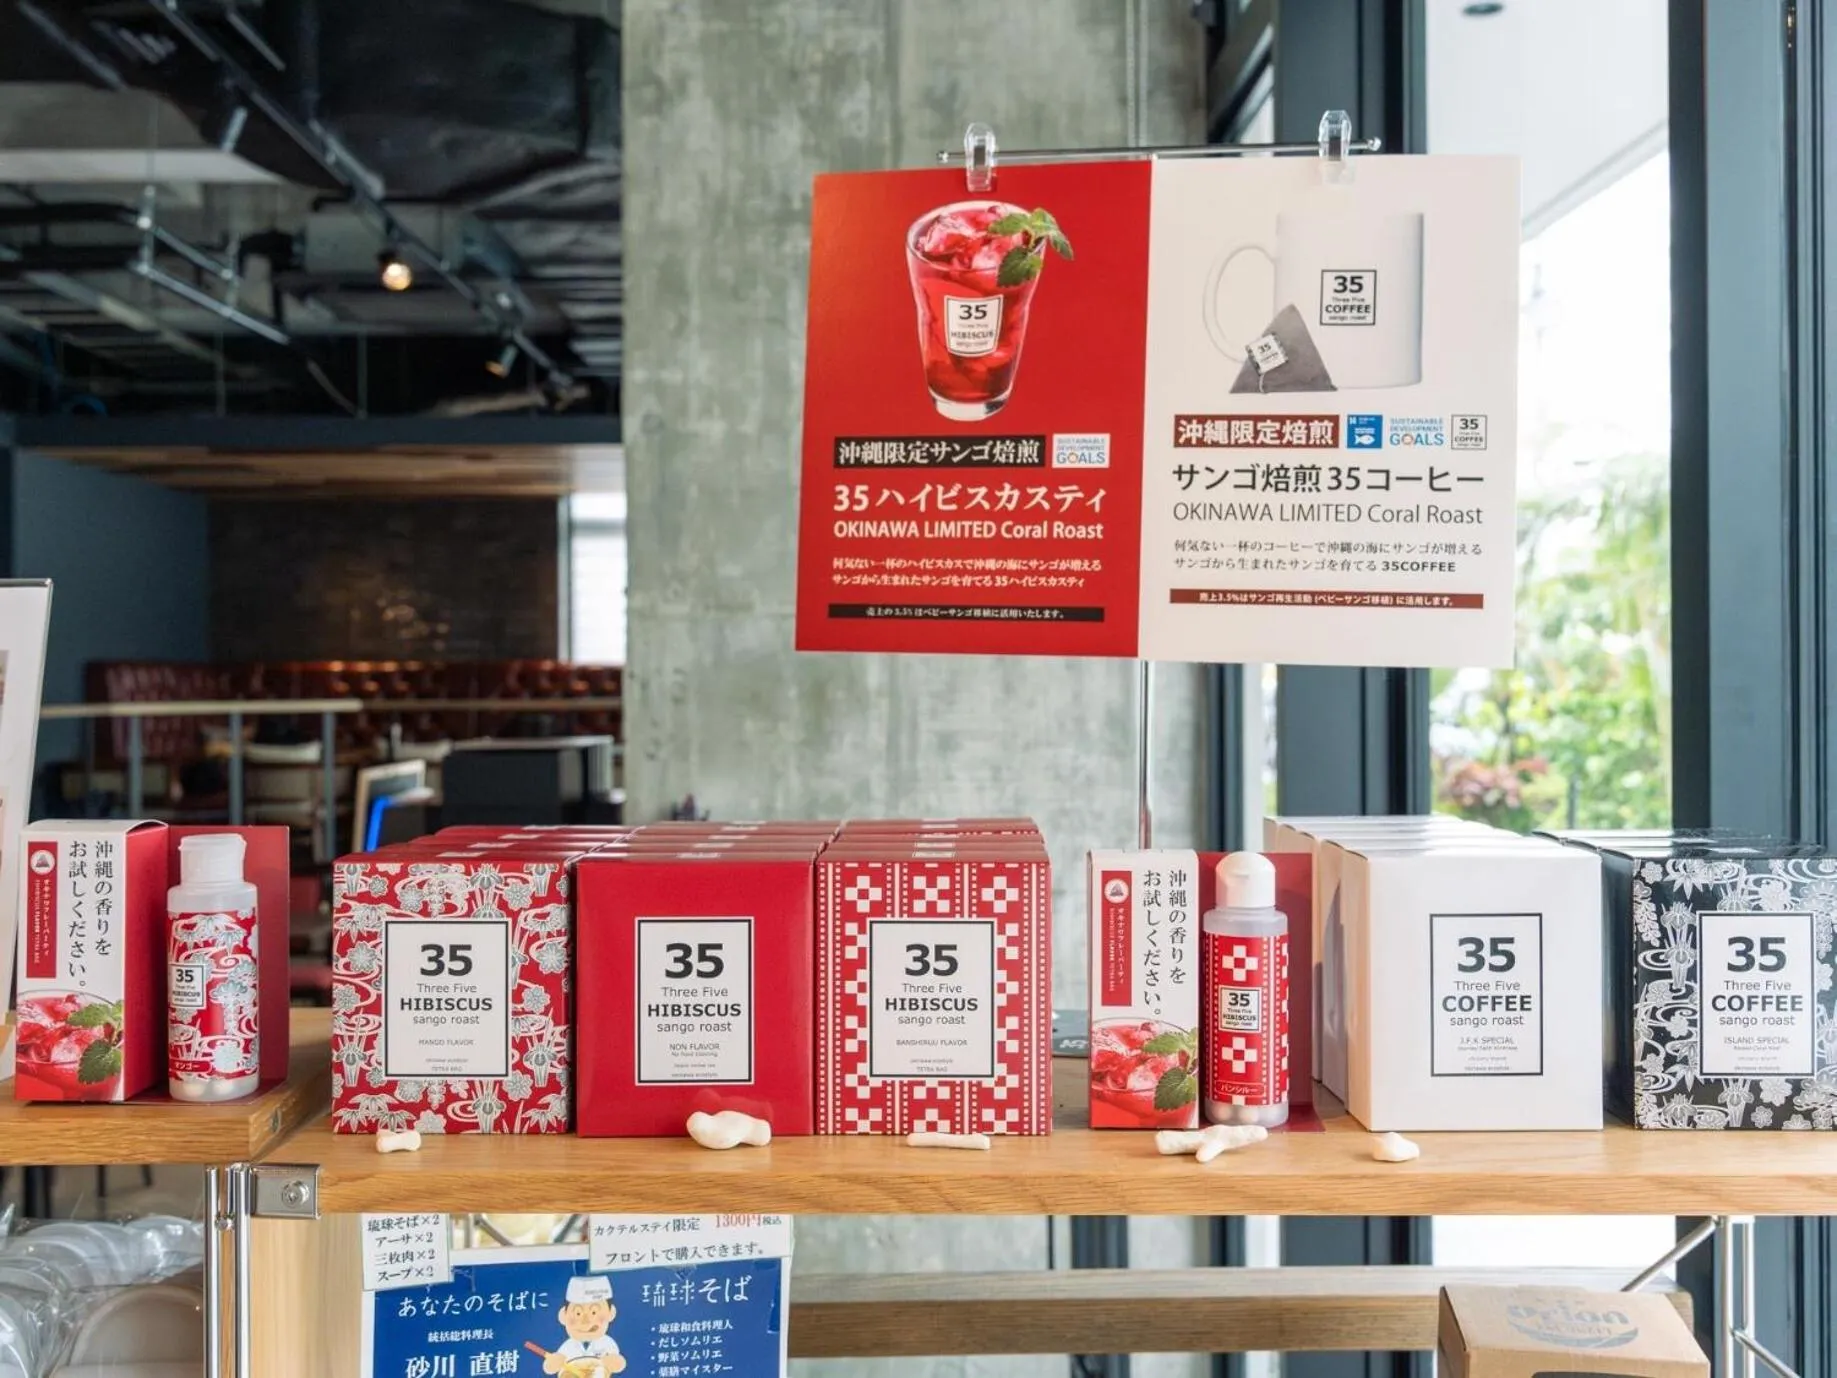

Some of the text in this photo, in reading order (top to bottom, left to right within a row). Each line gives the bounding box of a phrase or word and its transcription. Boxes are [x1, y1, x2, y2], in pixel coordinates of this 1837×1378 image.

[1333, 275, 1364, 294] 35
[959, 304, 987, 320] 35
[1325, 304, 1371, 314] COFFEE
[1459, 418, 1479, 430] 35
[1177, 420, 1335, 446] 沖縄限定焙煎
[1389, 433, 1445, 446] GOALS
[838, 440, 1040, 464] 沖縄限定サンゴ焙煎
[1172, 463, 1485, 493] サンゴ焙煎35コーヒー
[1173, 502, 1483, 524] OKINAWA LIMITED Coral Roast
[833, 520, 1104, 540] OKINAWA LIMITED Coral Roast
[94, 840, 114, 957] 沖縄の香りを
[68, 841, 88, 988] お試しください。
[1168, 869, 1188, 985] 沖縄の香りを
[1143, 869, 1162, 1016] お試しください。
[420, 944, 473, 976] 35
[665, 943, 724, 979] 35
[905, 944, 958, 976] 35
[1457, 937, 1516, 973] 35
[1727, 936, 1787, 972] 35
[175, 968, 195, 983] 35
[417, 983, 477, 993] Three Five
[662, 987, 729, 997] Three Five
[902, 983, 962, 993] Three Five
[1454, 981, 1520, 991] Three Five
[1724, 980, 1792, 990] Three Five
[400, 998, 492, 1011] HIBISCUS
[885, 998, 978, 1011] HIBISCUS
[1228, 992, 1251, 1007] 35
[1442, 995, 1532, 1012] COFFEE
[1712, 995, 1803, 1012] COFFEE
[648, 1004, 741, 1017] HIBISCUS
[413, 1015, 480, 1026] sango roast
[657, 1022, 732, 1034] sango roast
[898, 1015, 965, 1027] sango roast
[1450, 1015, 1524, 1028] sango roast
[1719, 1015, 1795, 1028] sango roast
[605, 1241, 764, 1265] フロントで購入できます。
[641, 1275, 753, 1308] 琉球そば
[398, 1291, 549, 1317] あなたのそばに
[658, 1336, 723, 1348] だしソムリエ
[405, 1349, 520, 1378] 砂川 直樹
